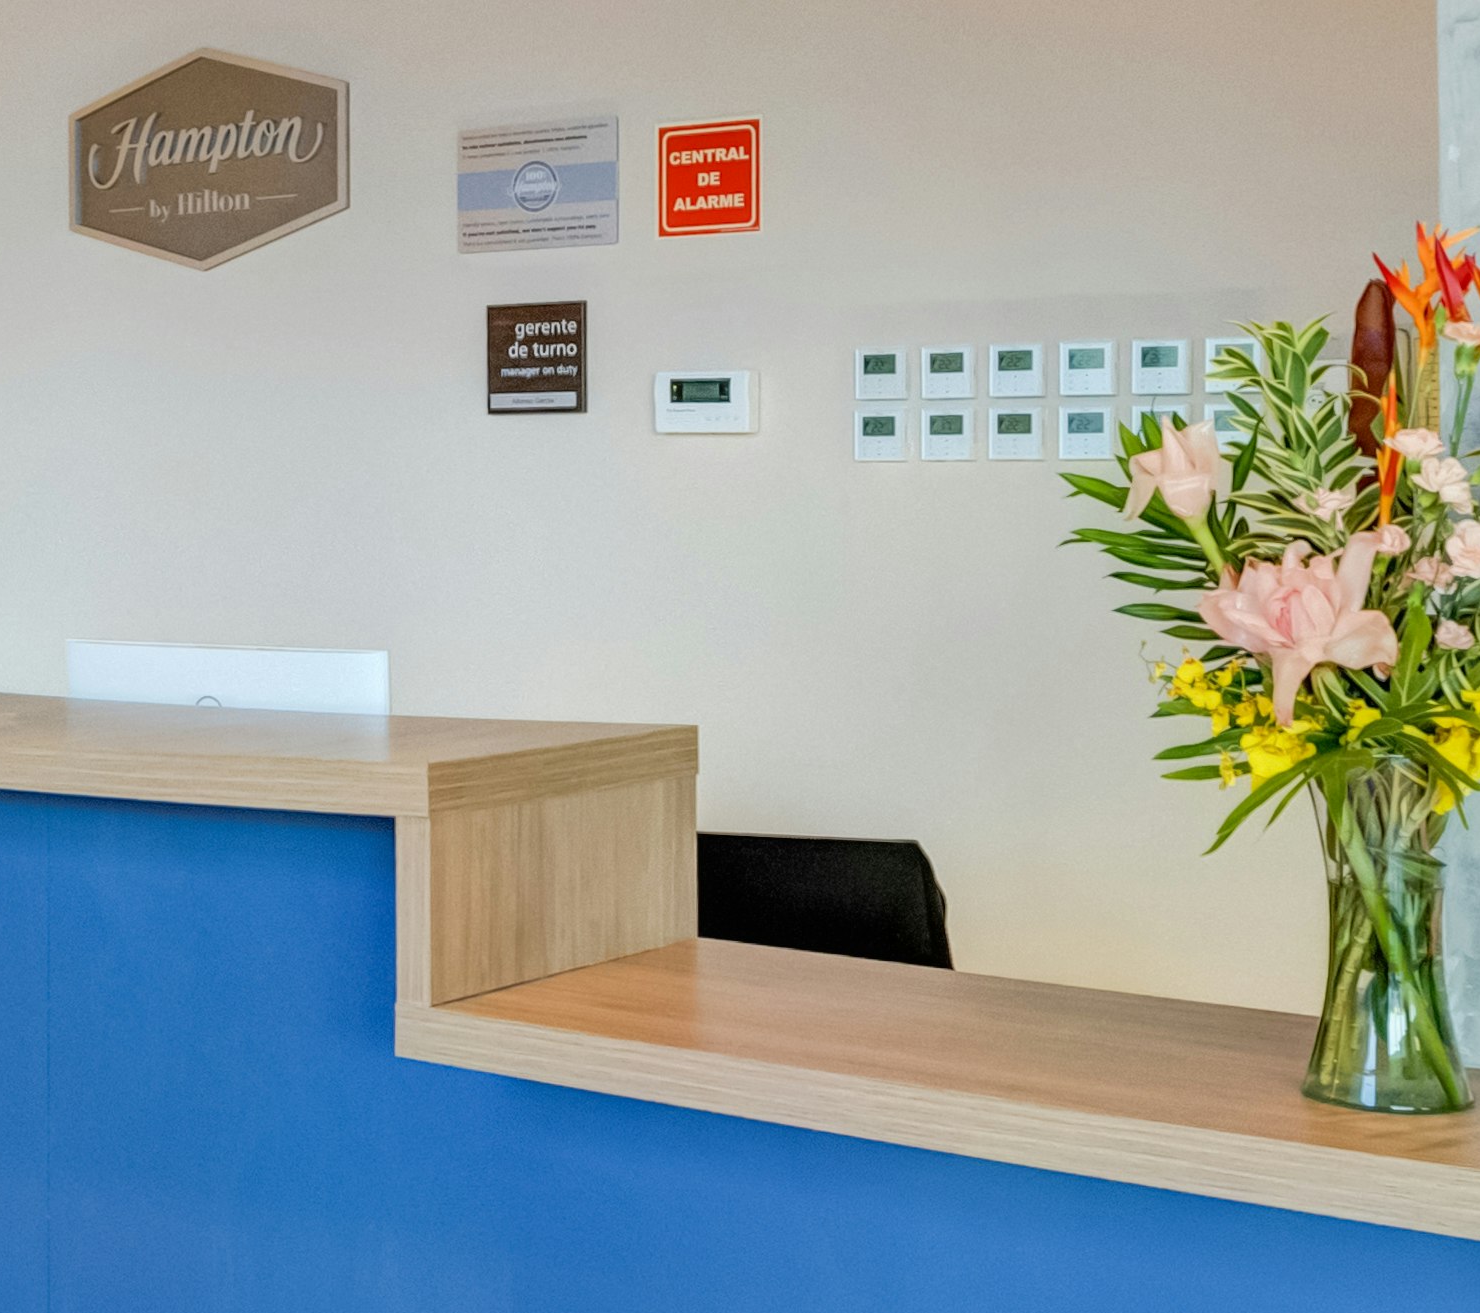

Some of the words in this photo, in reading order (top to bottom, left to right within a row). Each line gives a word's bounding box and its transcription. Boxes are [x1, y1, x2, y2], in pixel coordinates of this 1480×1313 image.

[88, 109, 323, 189] Hampton
[669, 146, 749, 165] CENTRAL
[698, 172, 720, 186] DE
[149, 200, 171, 223] by
[177, 189, 250, 215] Hilton
[673, 193, 744, 211] ALARME
[515, 319, 577, 341] gerente
[508, 341, 528, 358] de
[533, 342, 577, 358] turno
[501, 367, 540, 379] manager
[542, 366, 554, 375] on
[557, 364, 578, 376] duty
